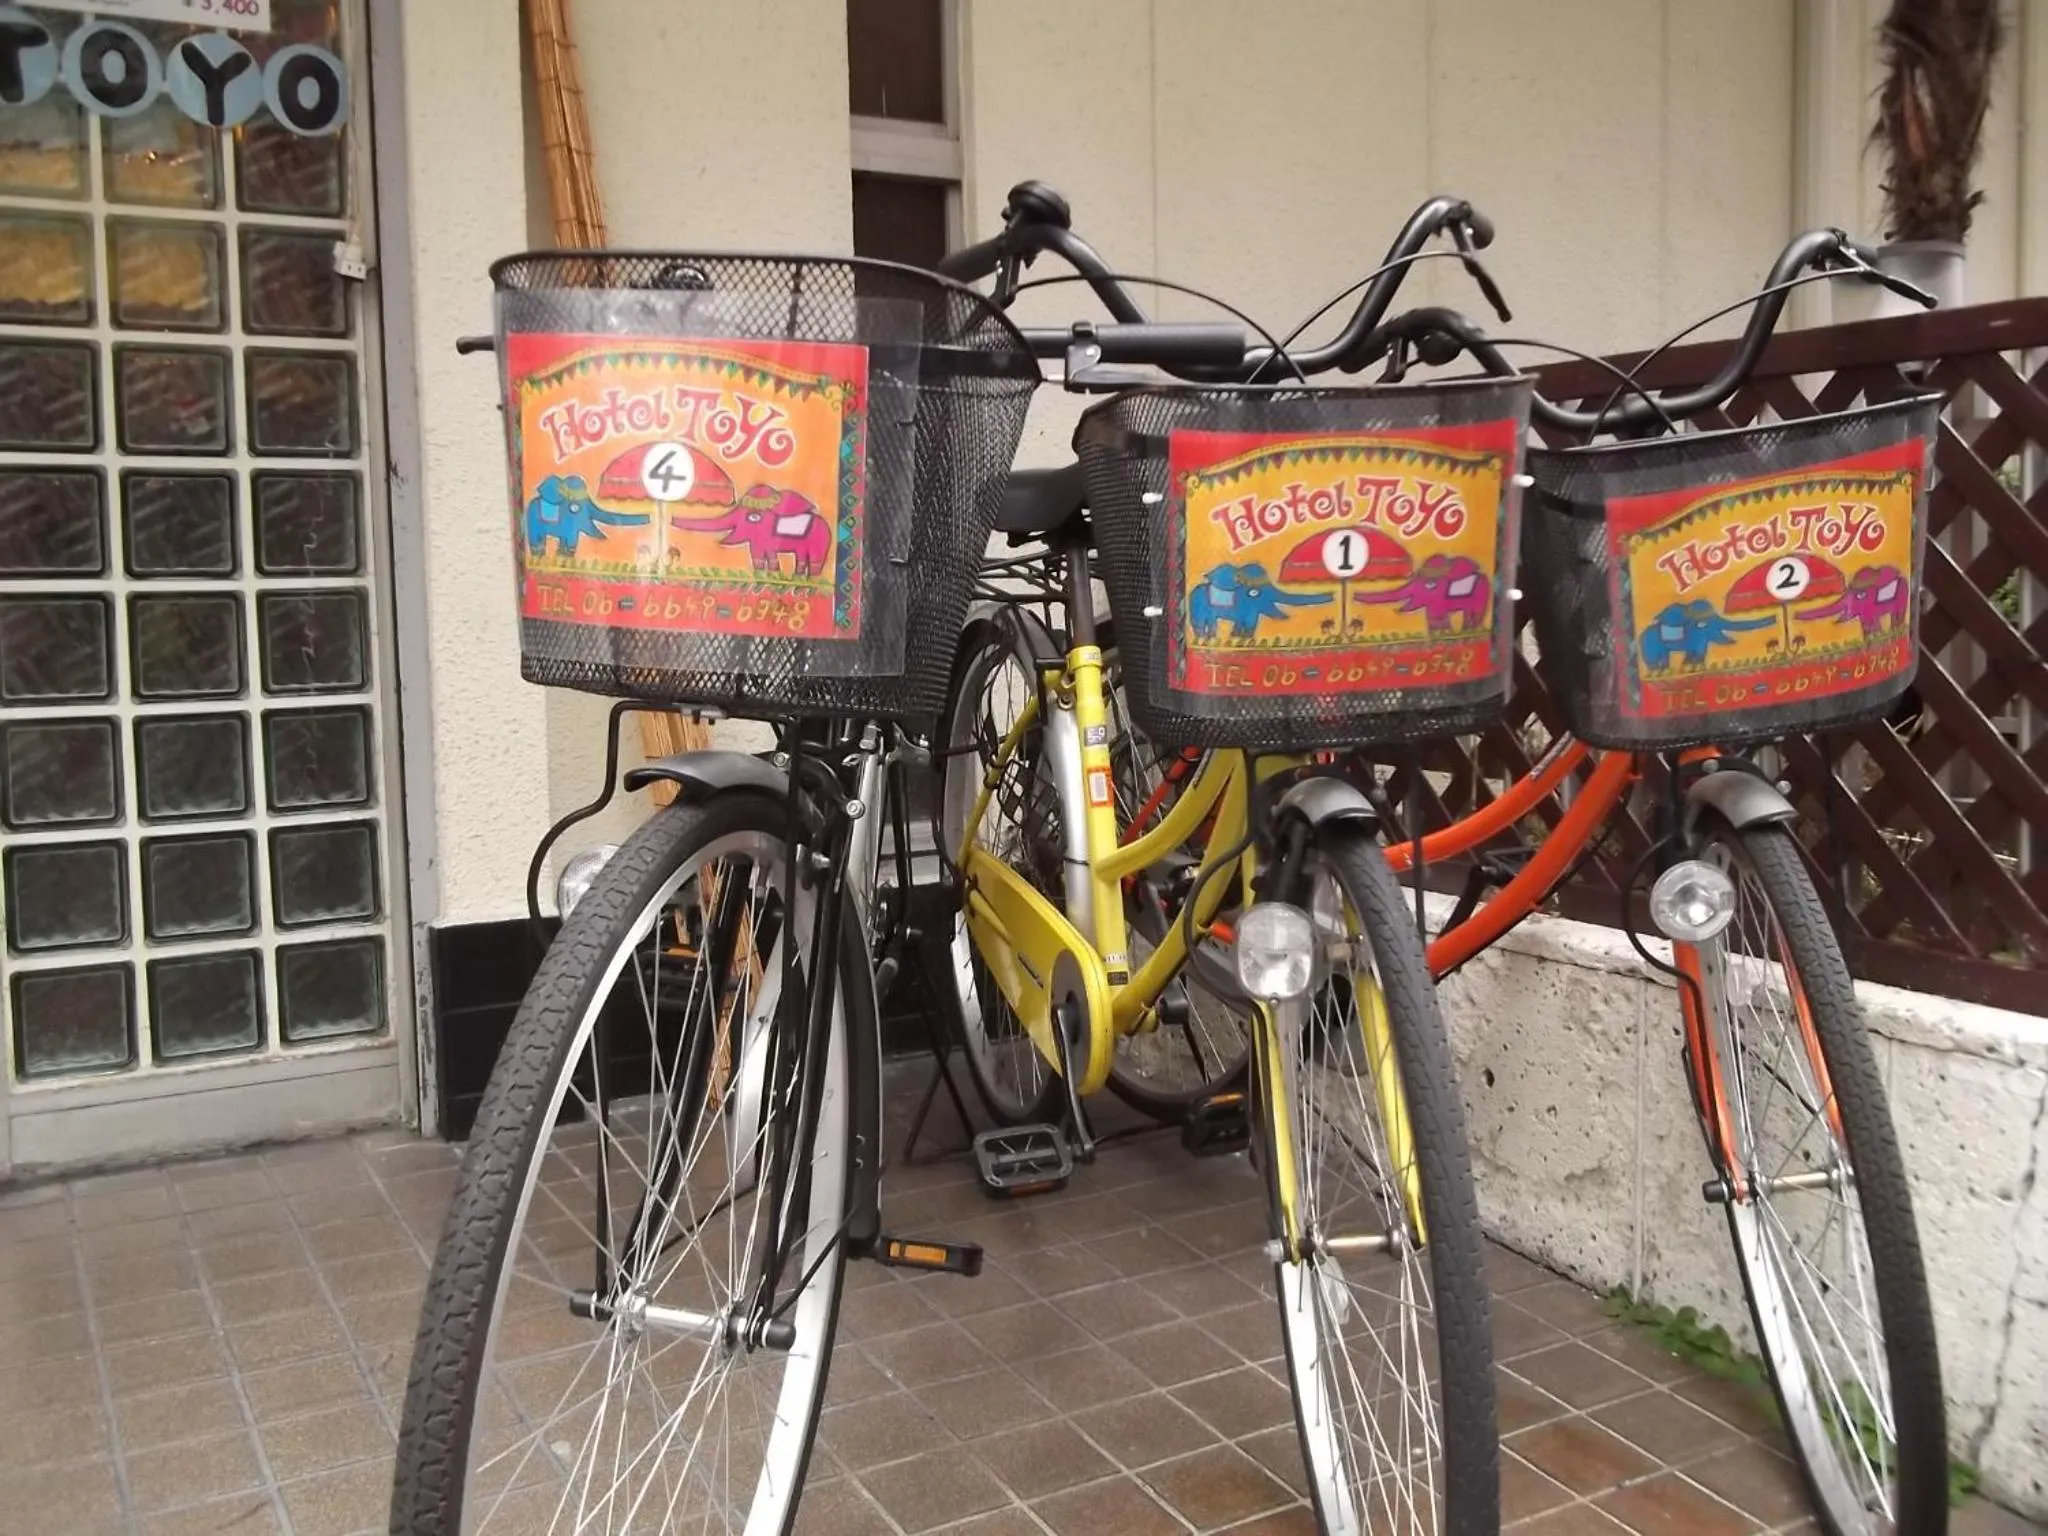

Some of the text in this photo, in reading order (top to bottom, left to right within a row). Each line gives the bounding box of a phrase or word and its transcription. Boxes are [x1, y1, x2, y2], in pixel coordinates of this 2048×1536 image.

[541, 389, 671, 462] Hotel
[648, 450, 687, 492] 4
[1211, 479, 1352, 551] Hotel
[1337, 535, 1354, 571] 1
[1657, 516, 1786, 593] Hotel
[1775, 563, 1800, 590] 2
[537, 584, 575, 613] TEL
[1204, 663, 1254, 688] TEL
